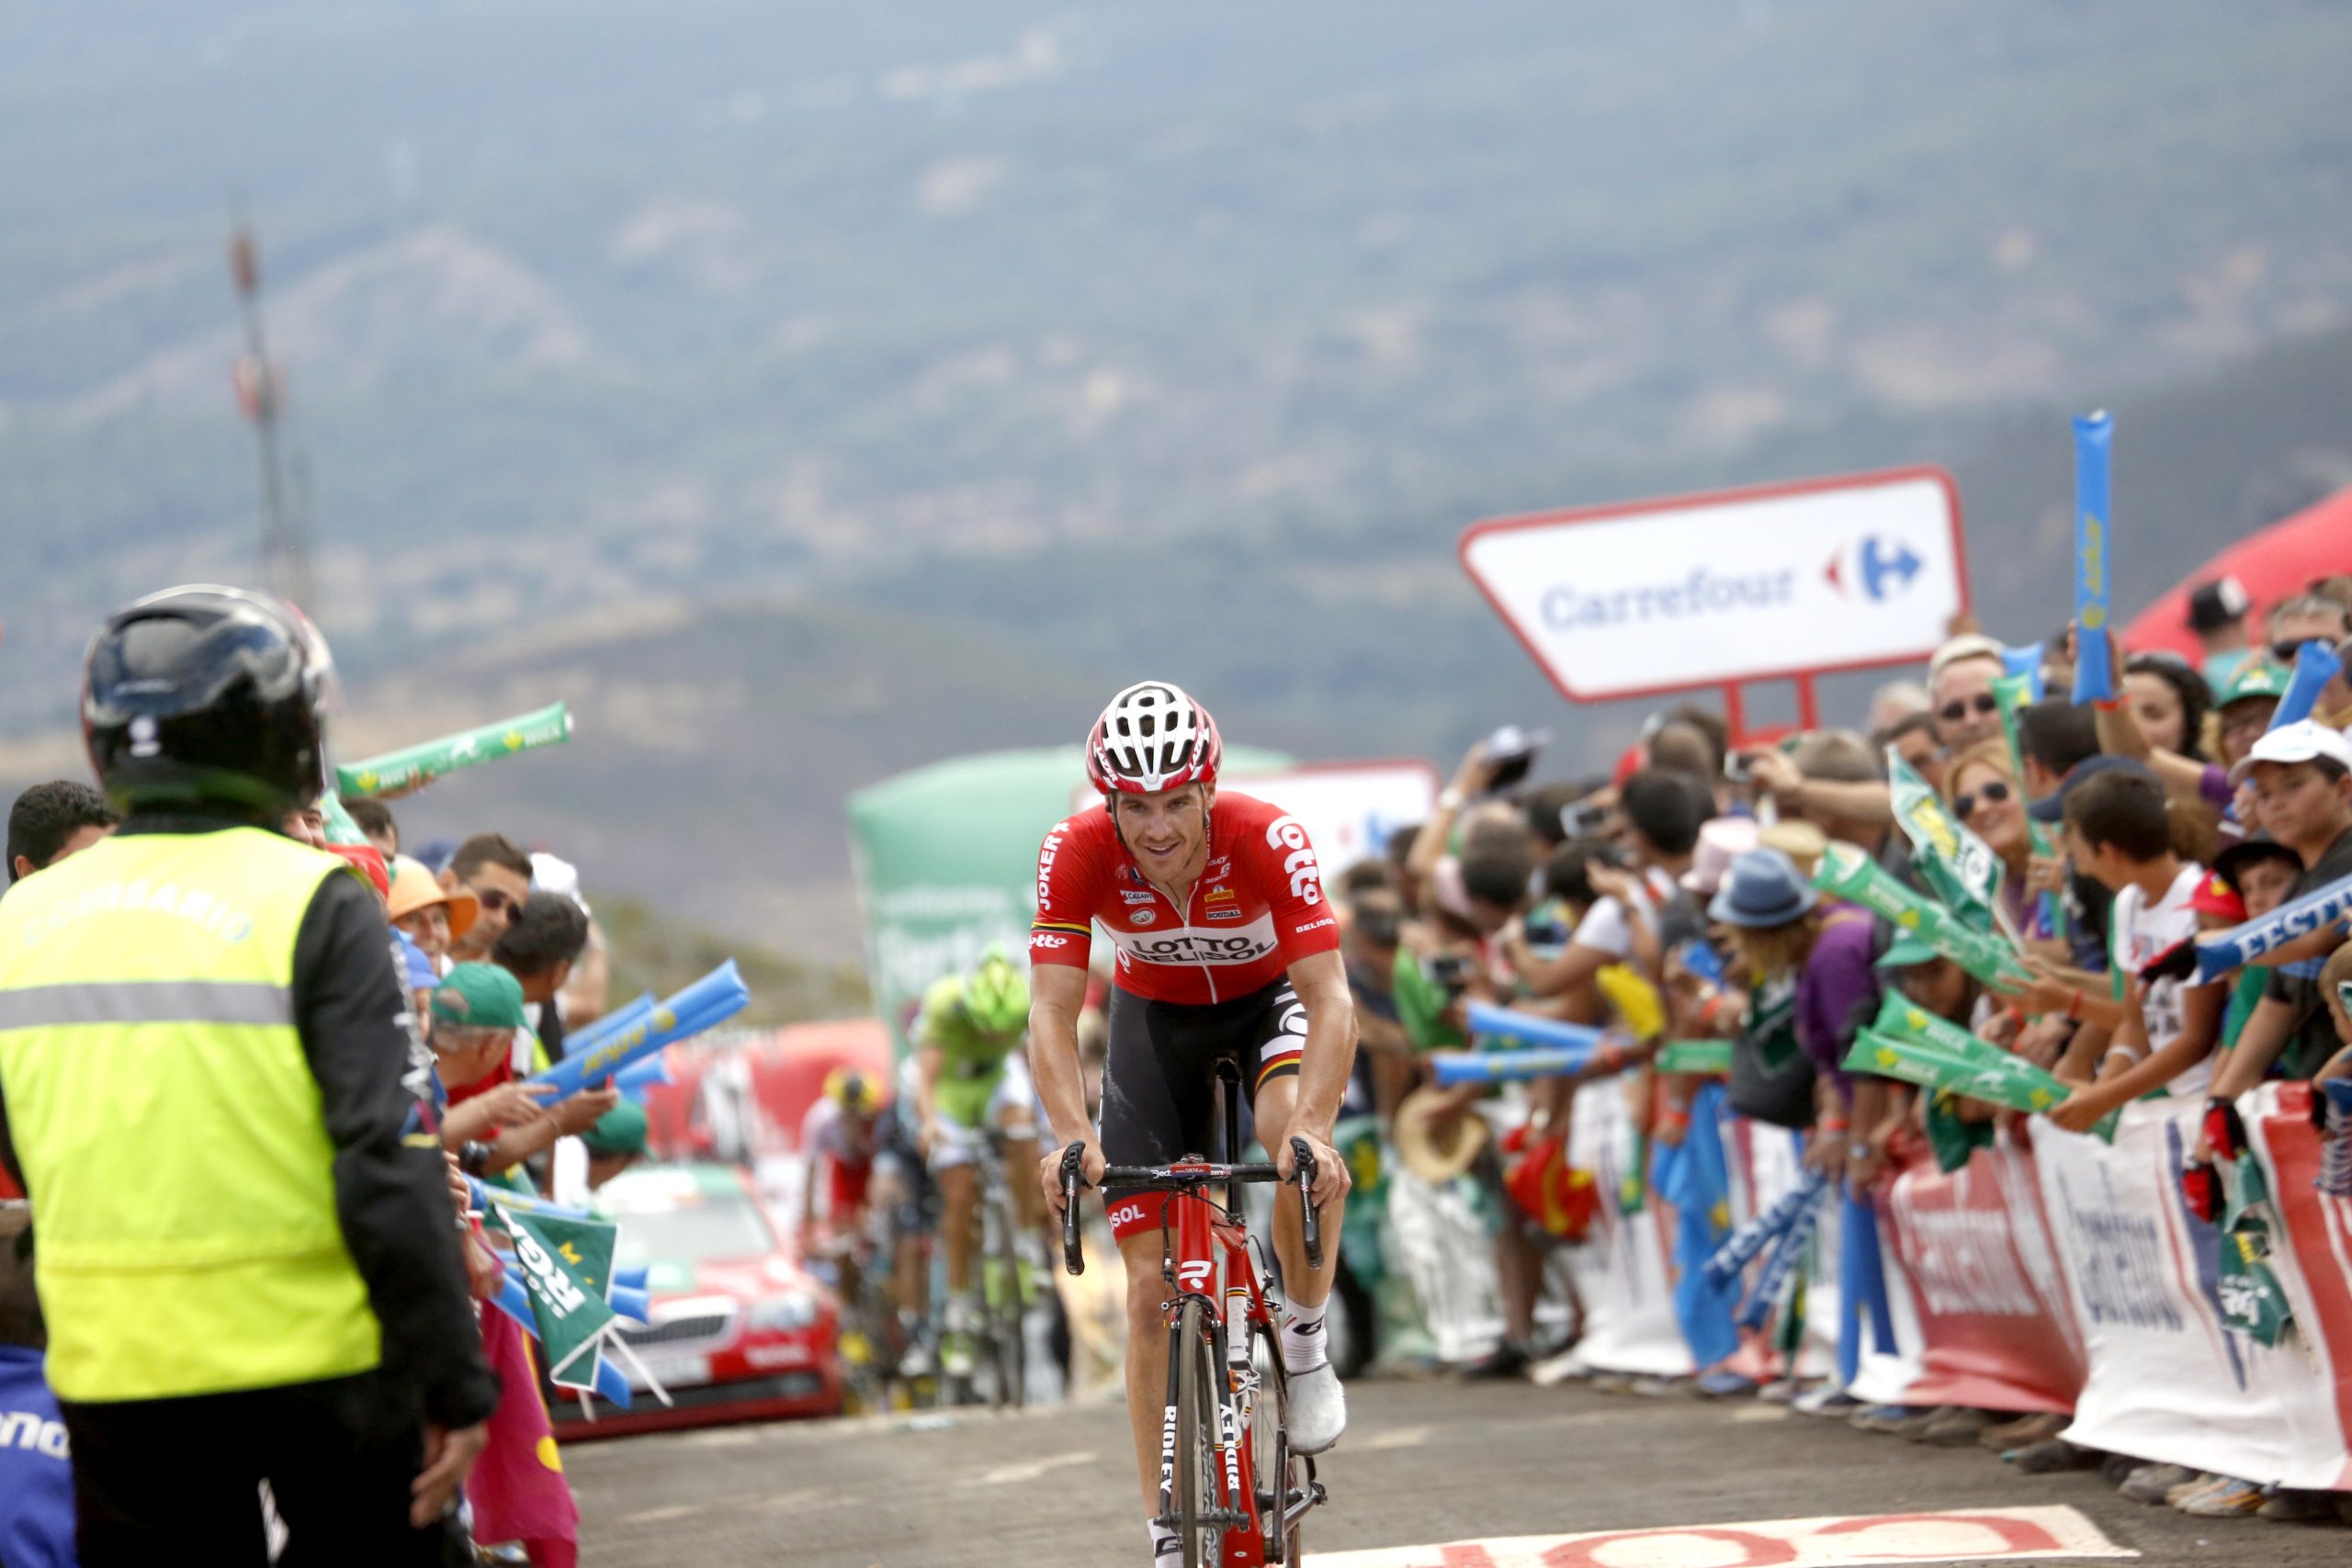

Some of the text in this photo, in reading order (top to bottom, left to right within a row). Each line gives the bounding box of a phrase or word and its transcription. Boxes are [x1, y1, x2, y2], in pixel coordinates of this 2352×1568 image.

[1541, 562, 1798, 631] Carrefour
[1097, 746, 1118, 782] LAZER
[1207, 910, 1240, 919] SOUDAL
[1296, 919, 1336, 933] BELISOL
[1133, 937, 1250, 954] LOTTO
[1109, 1204, 1146, 1231] ISOL
[1160, 1405, 1177, 1495] RIDLEY
[1219, 1404, 1239, 1489] RIDLEY
